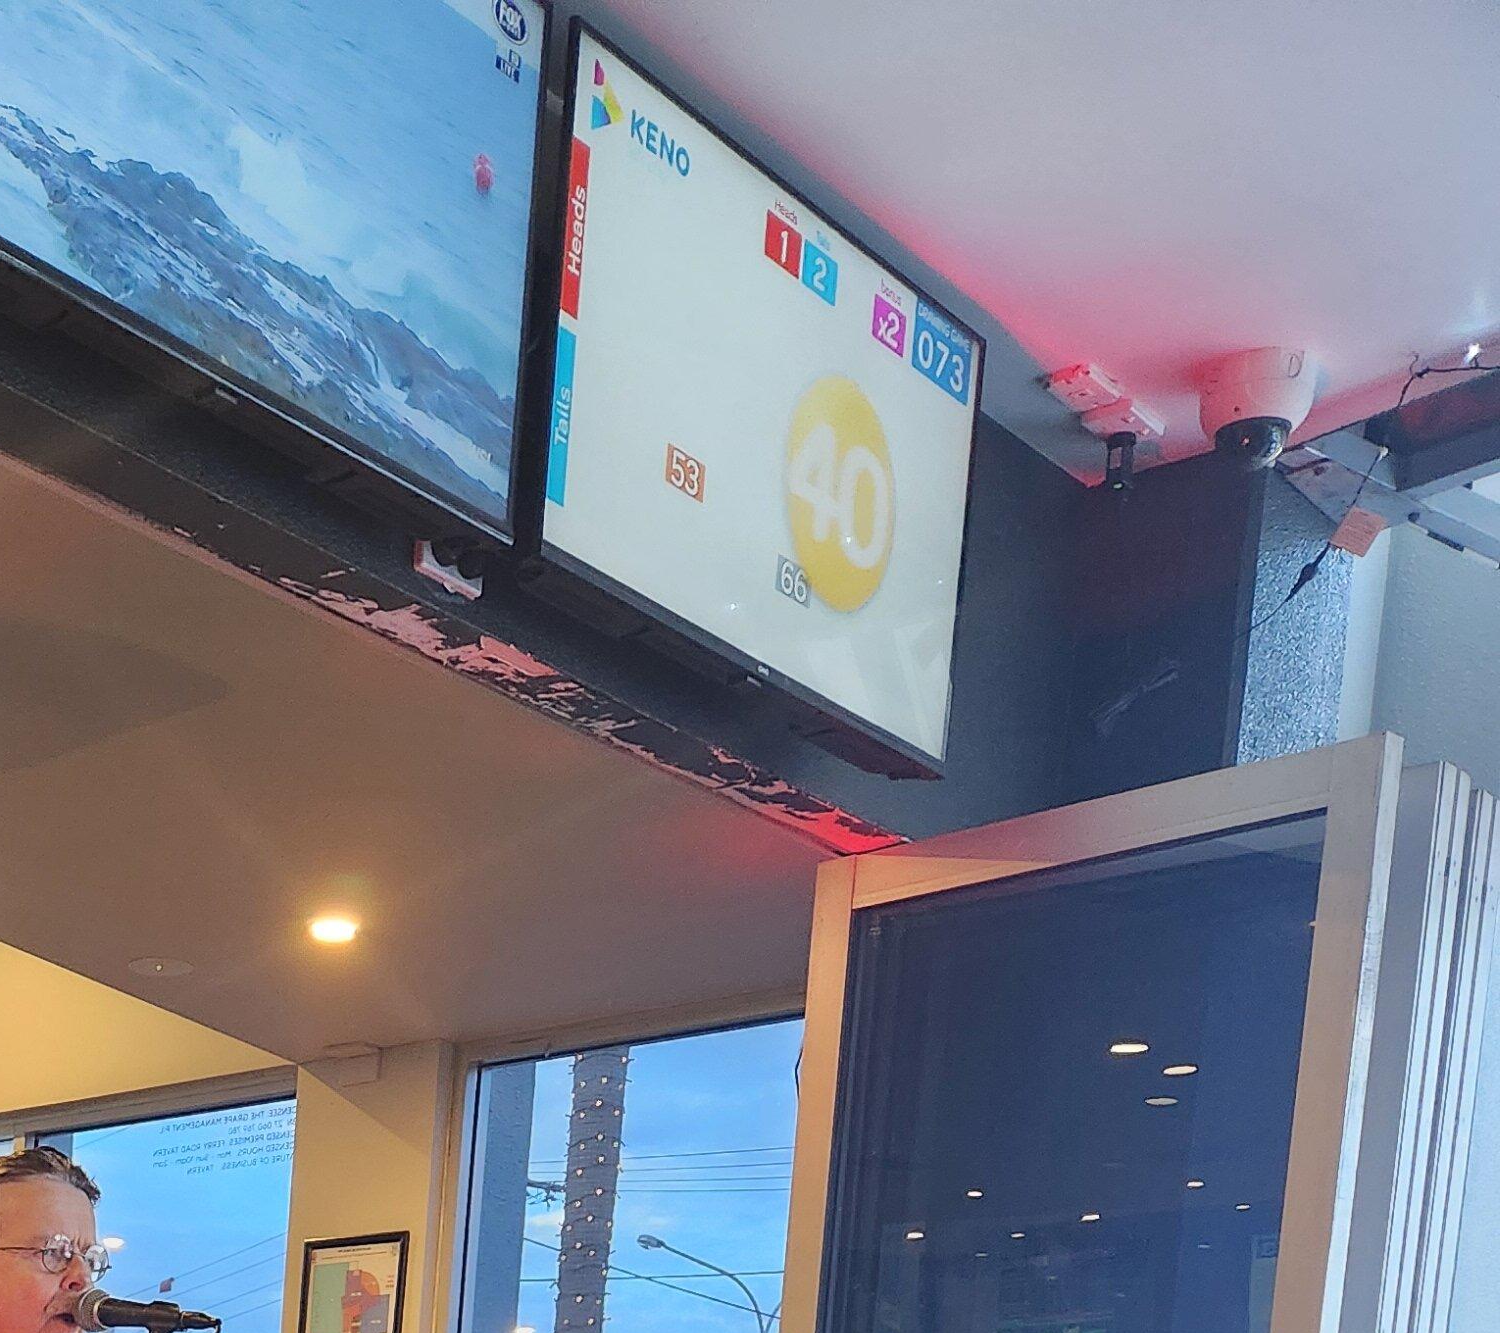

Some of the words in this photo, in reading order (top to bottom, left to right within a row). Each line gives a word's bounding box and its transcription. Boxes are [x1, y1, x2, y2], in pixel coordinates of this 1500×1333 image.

[630, 109, 691, 177] KENO
[566, 184, 588, 277] Heads
[779, 230, 788, 264] 1
[811, 255, 828, 292] 2
[876, 310, 901, 350] x2
[917, 330, 965, 394] 073
[553, 385, 572, 448] Tails
[670, 451, 701, 497] 53
[788, 422, 888, 569] 40
[780, 560, 807, 604] 66
